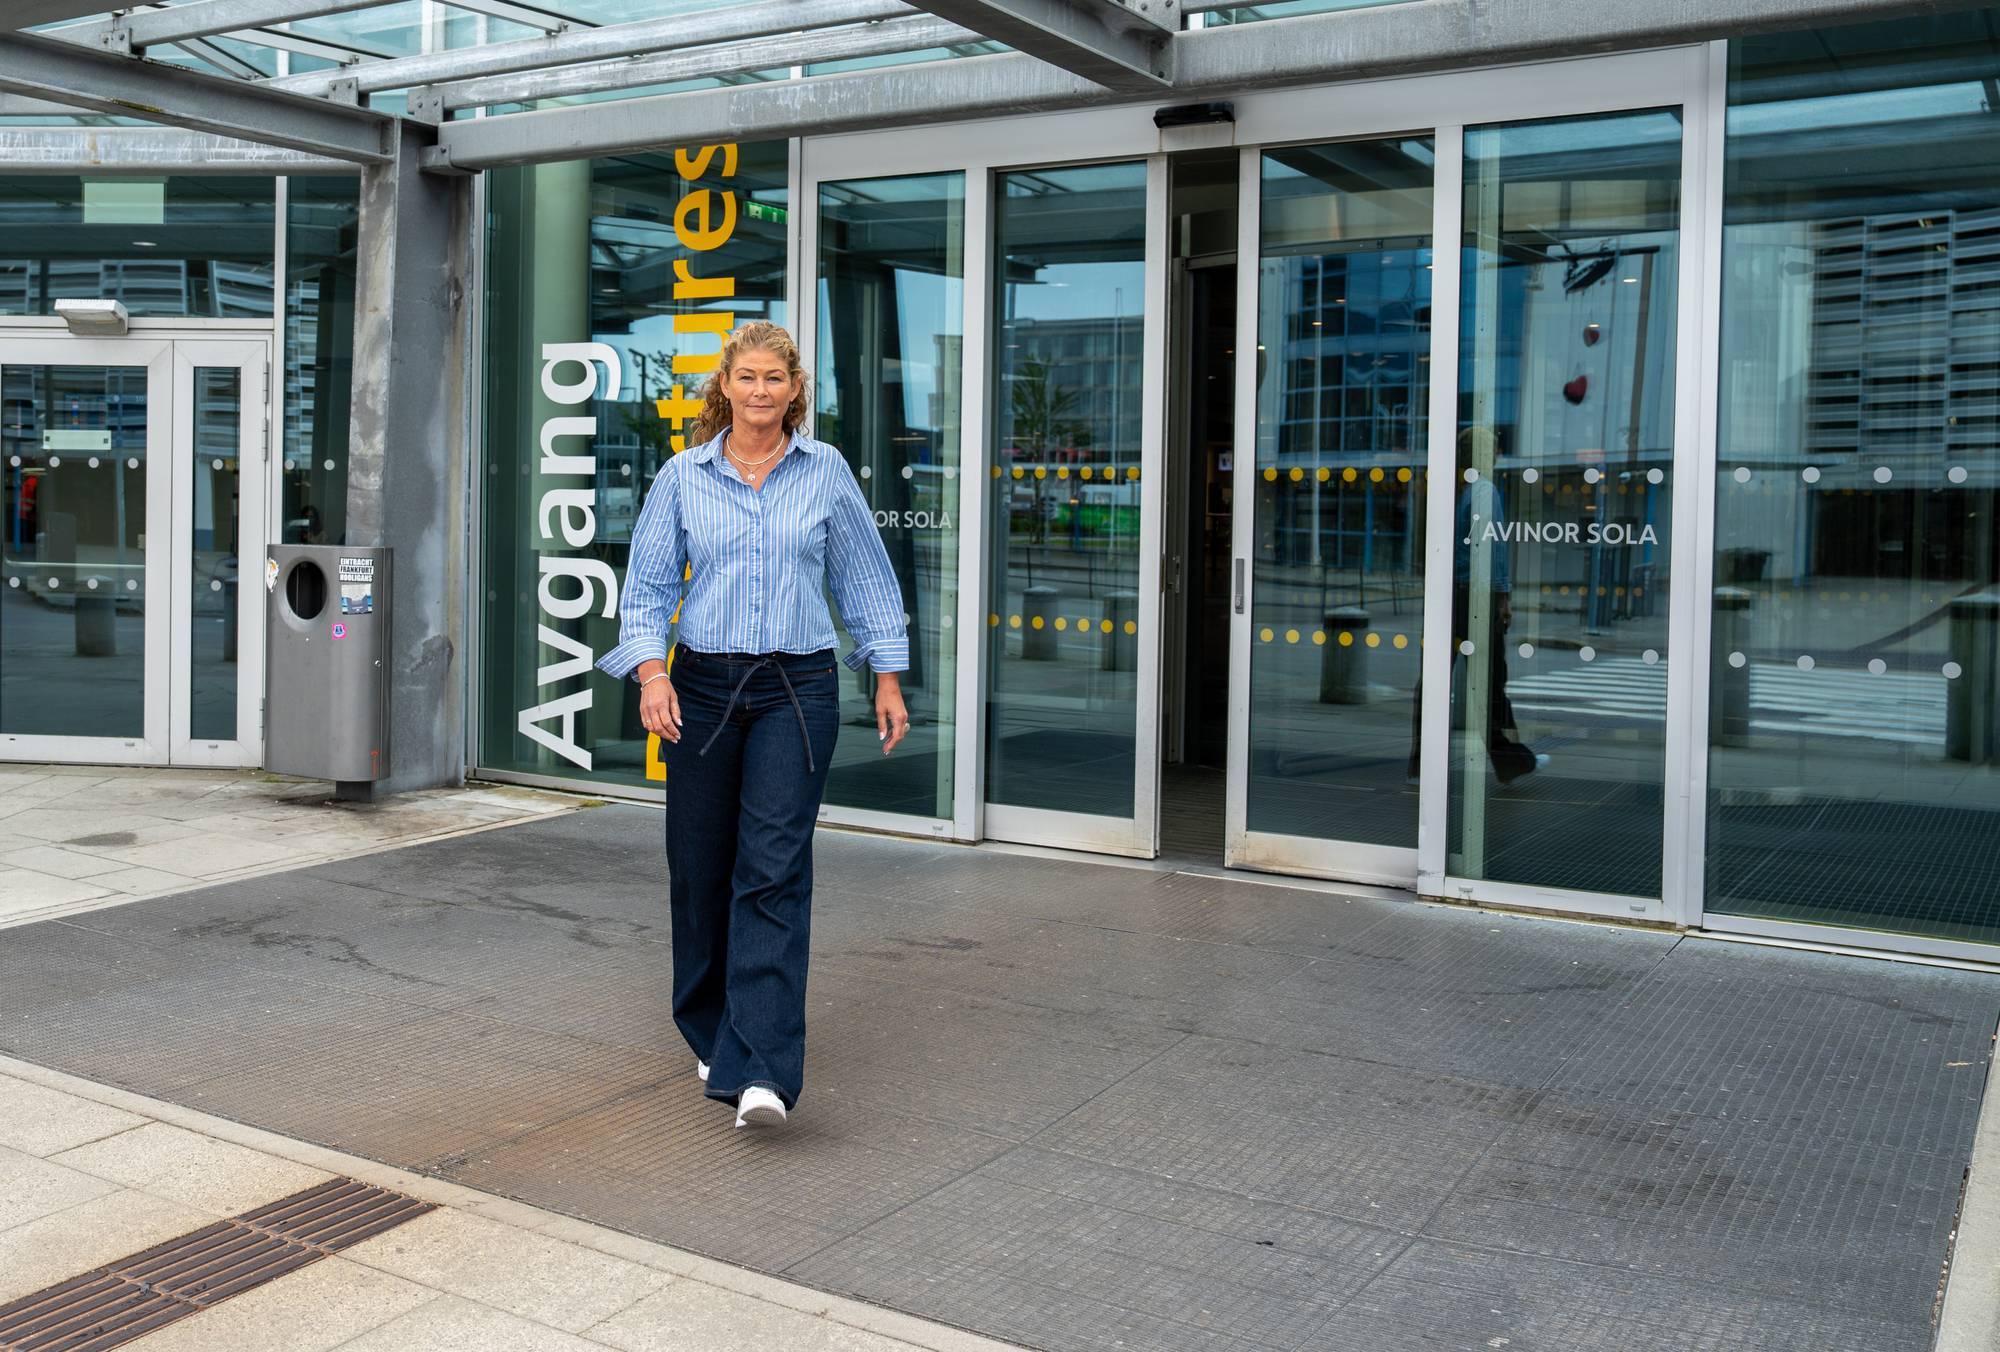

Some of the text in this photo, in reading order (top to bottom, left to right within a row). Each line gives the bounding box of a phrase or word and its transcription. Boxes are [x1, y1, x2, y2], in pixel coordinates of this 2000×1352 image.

[646, 143, 737, 781] tures
[903, 510, 953, 529] SOLA
[1481, 520, 1659, 545] AVINOR SOLA
[340, 557, 373, 566] EINTRACHT
[517, 341, 622, 772] Avgang
[340, 566, 373, 574] FRANKFURT
